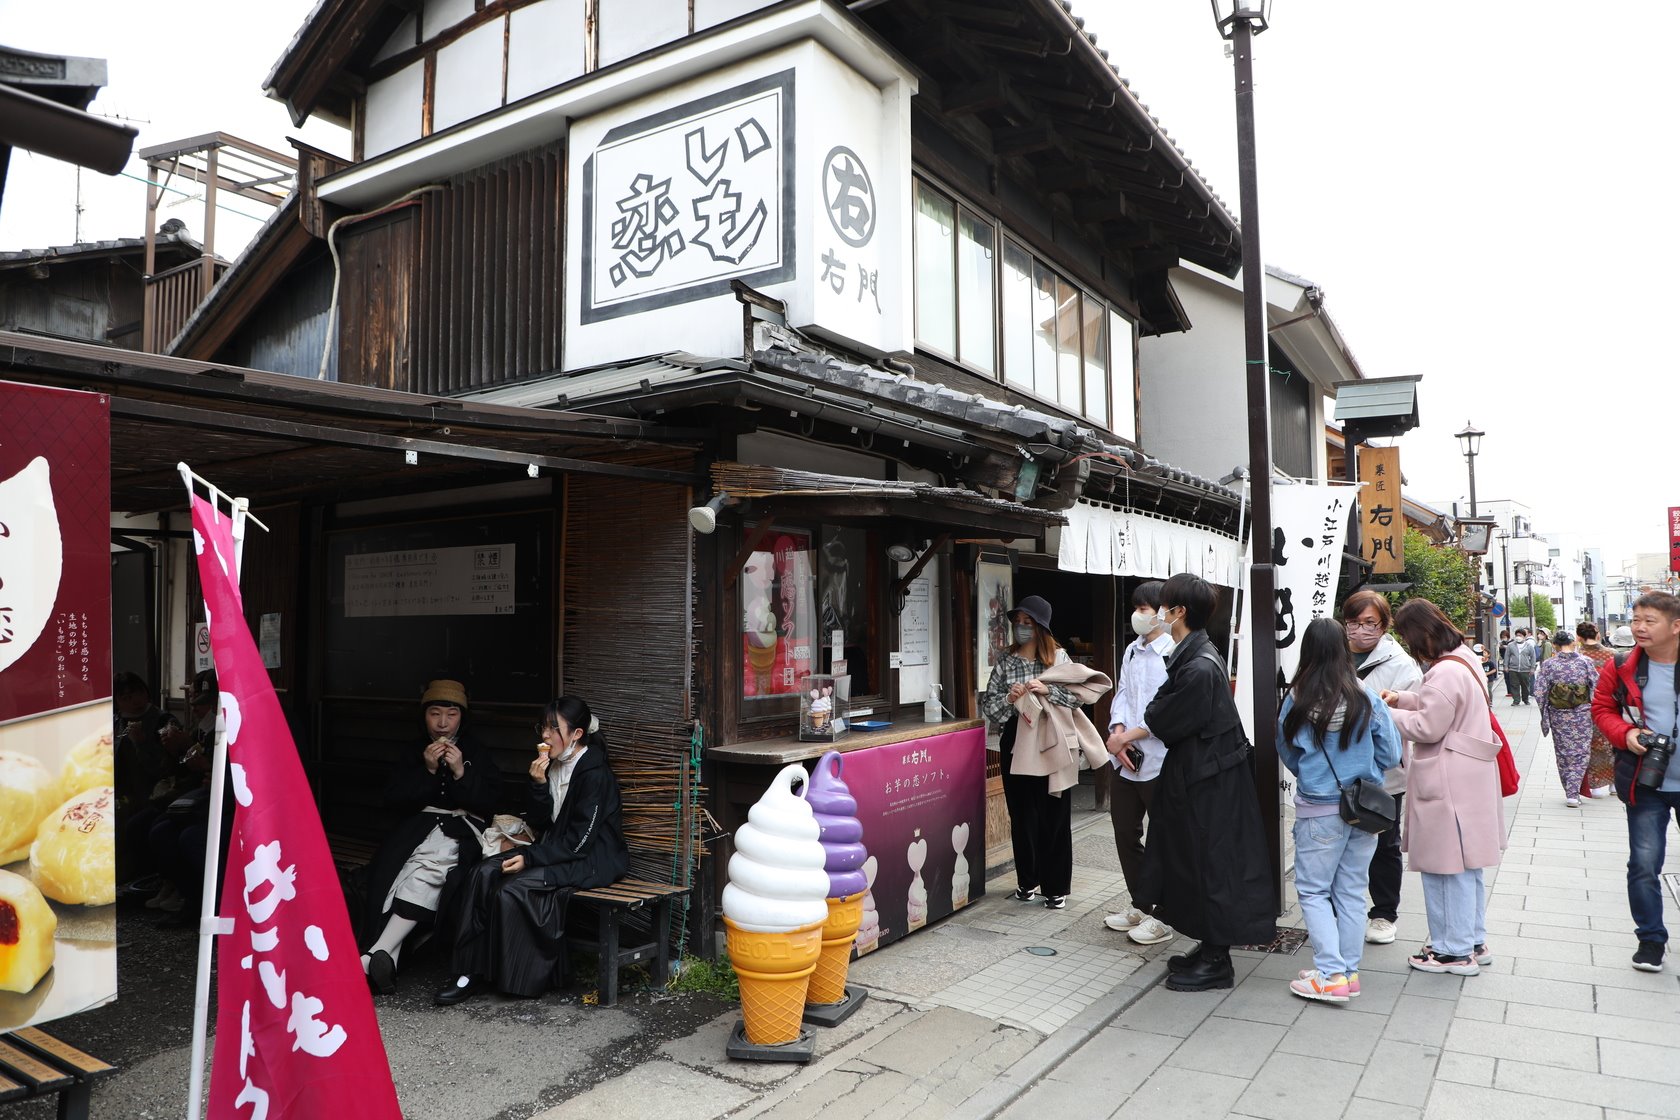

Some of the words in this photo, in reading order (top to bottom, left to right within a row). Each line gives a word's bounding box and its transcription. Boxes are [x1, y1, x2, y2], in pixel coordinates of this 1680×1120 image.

[831, 155, 872, 236] 右
[820, 248, 882, 316] 右門
[1369, 503, 1397, 561] 右門
[68, 612, 78, 656] 生地の妙が
[81, 612, 89, 682] もちもち感のある
[884, 768, 950, 795] お芋の恋ソフト。
